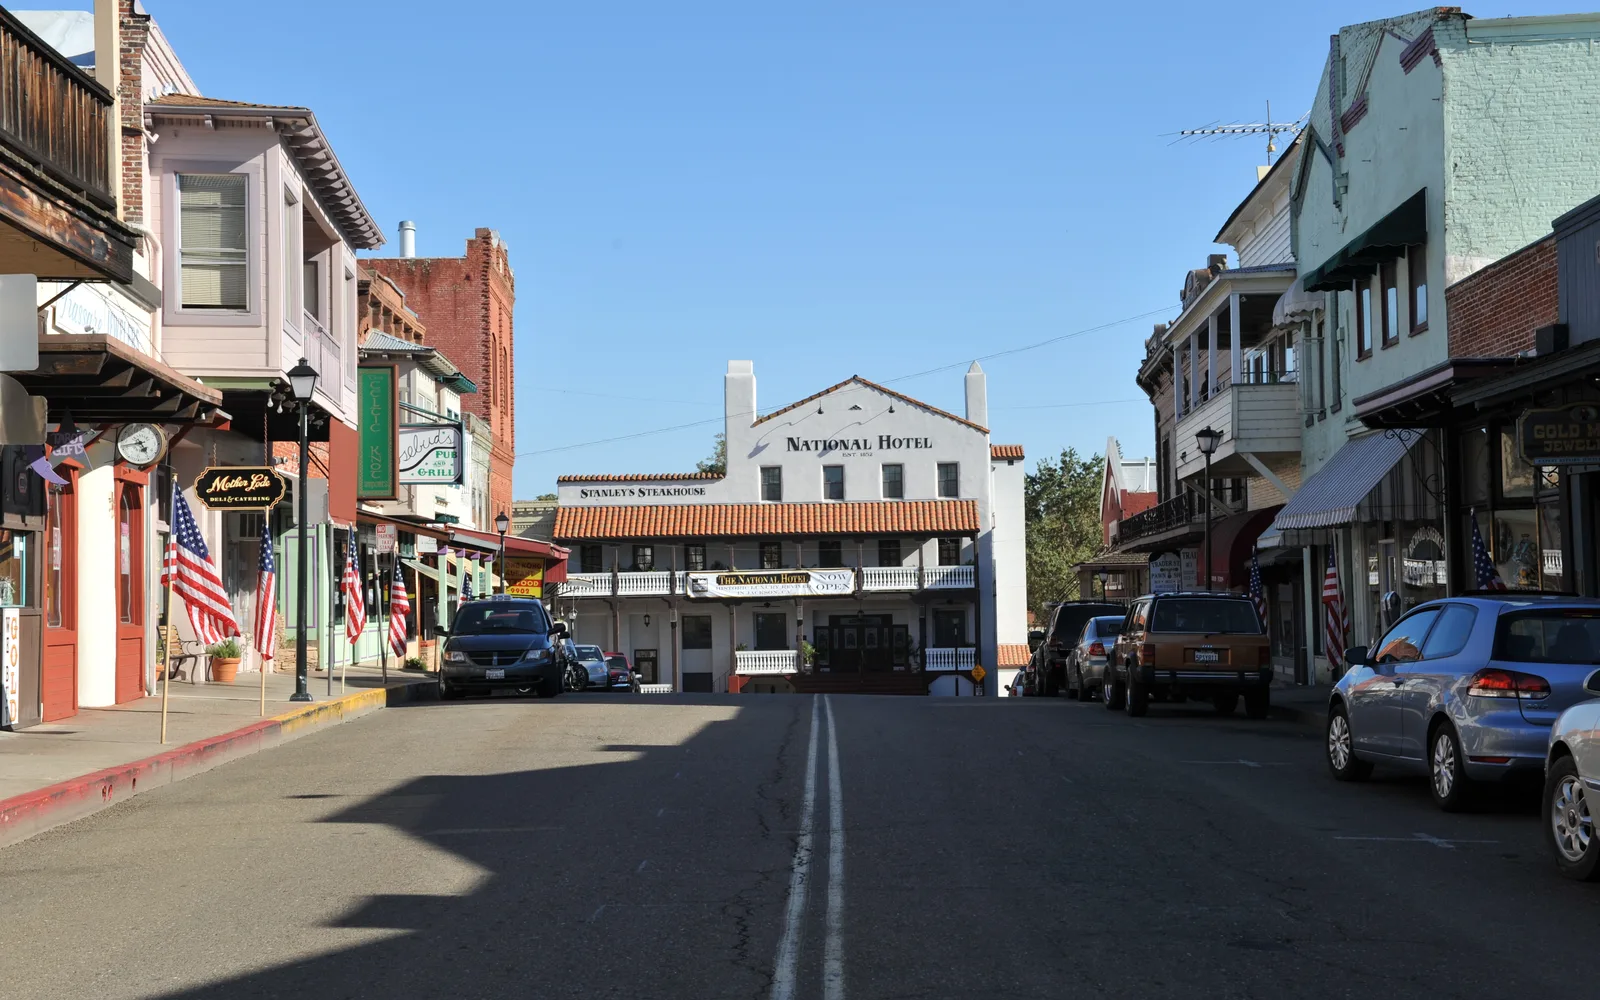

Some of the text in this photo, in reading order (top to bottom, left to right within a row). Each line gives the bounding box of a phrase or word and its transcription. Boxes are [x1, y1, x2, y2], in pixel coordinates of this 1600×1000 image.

[50, 431, 83, 445] TAROT
[1534, 424, 1580, 439] GOLD
[52, 443, 84, 456] GIFTS
[787, 435, 932, 452] NATIONAL HOTEL
[1544, 440, 1600, 452] JEWEL
[435, 451, 457, 459] PUB
[418, 468, 455, 477] GRILL
[206, 474, 270, 493] Mother Lode
[581, 487, 706, 499] STANLEY'S STEAKHOUSE
[720, 572, 807, 585] THE NATIONAL HOTEL
[816, 583, 851, 591] OPEN
[10, 617, 18, 722] GOLD
